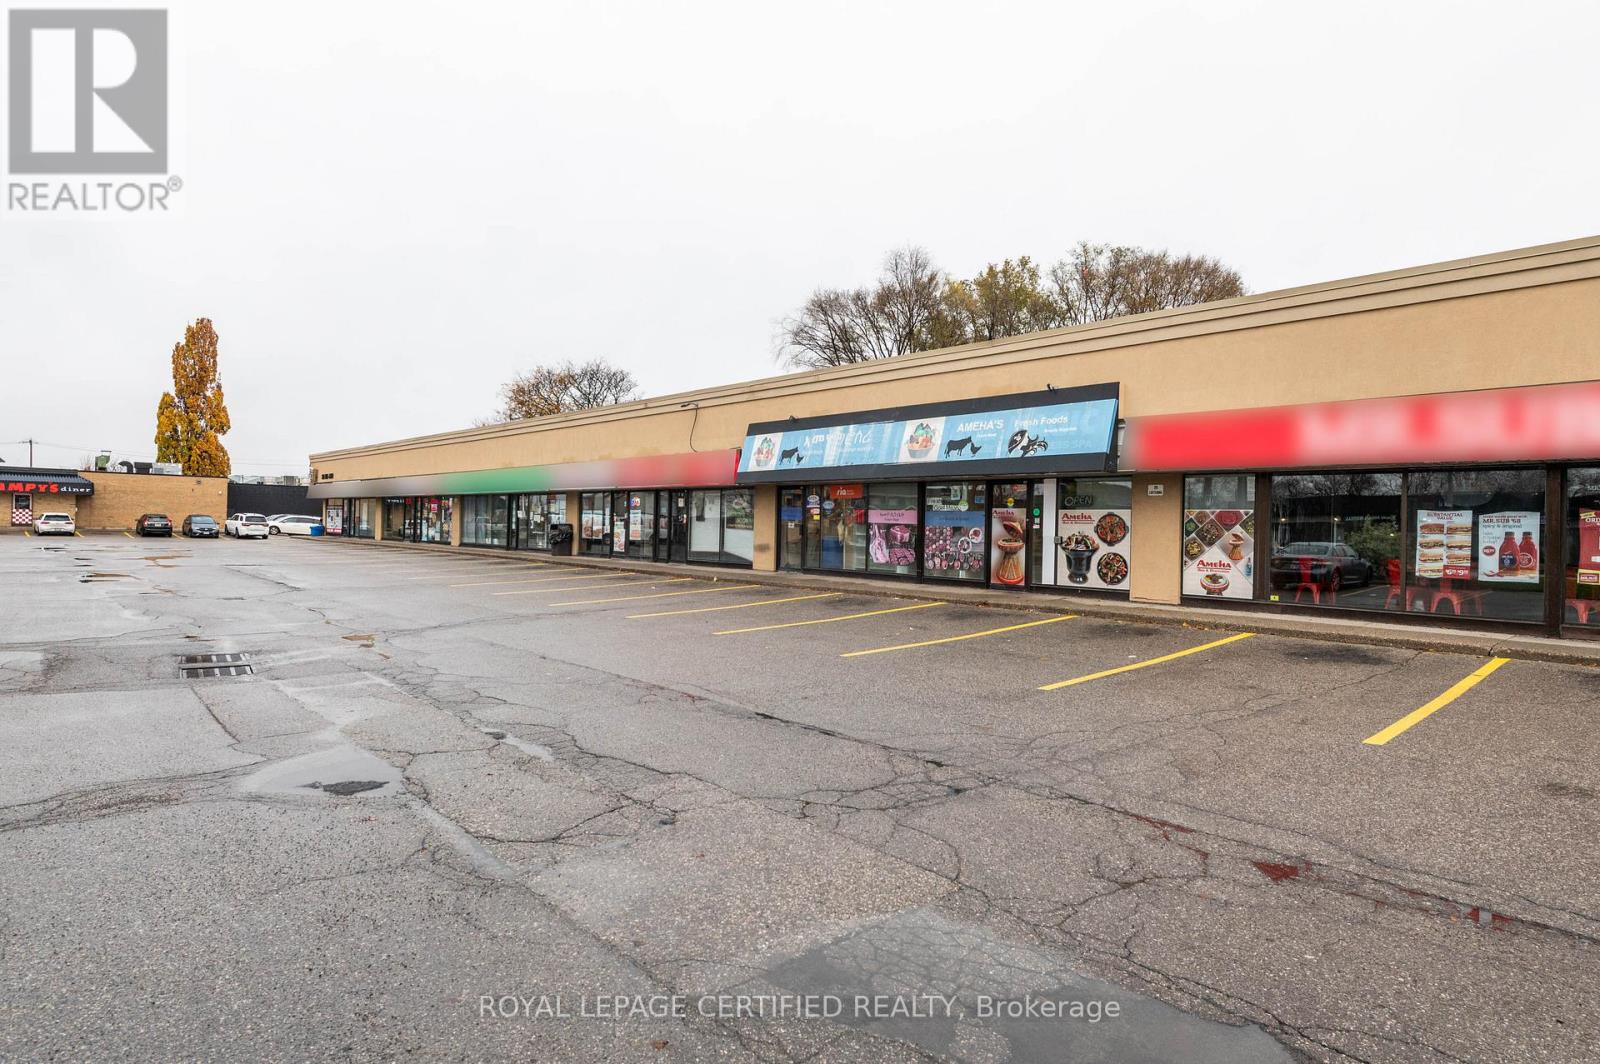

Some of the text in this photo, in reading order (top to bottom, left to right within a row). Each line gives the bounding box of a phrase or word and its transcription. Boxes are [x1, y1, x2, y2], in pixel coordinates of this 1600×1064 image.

[957, 419, 1005, 433] AMEHA'S
[1041, 415, 1069, 425] Foods
[1064, 496, 1092, 507] OPEN
